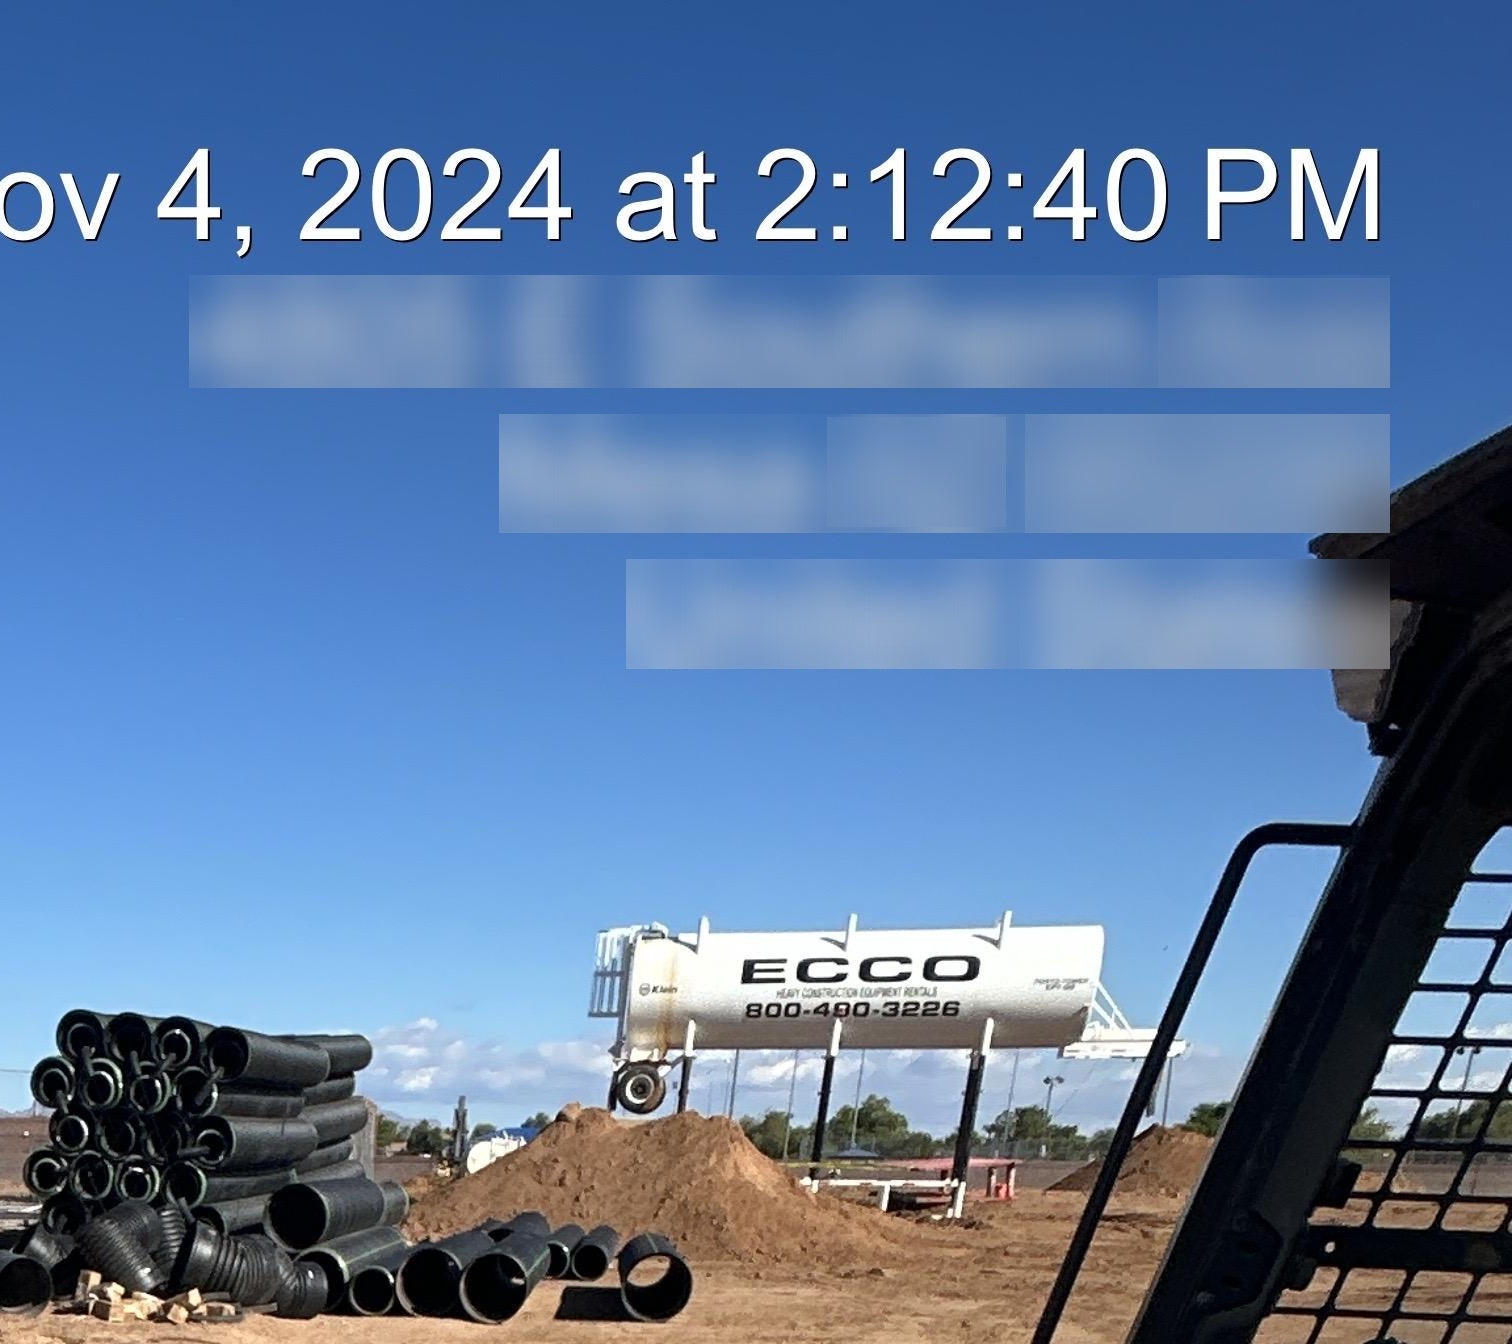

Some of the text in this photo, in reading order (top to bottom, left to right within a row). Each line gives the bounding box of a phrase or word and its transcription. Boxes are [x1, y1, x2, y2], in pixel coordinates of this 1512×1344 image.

[741, 955, 981, 984] ECCO
[776, 985, 938, 999] HEAVY CONSTRUCTION EQUIPMENT RENTALS
